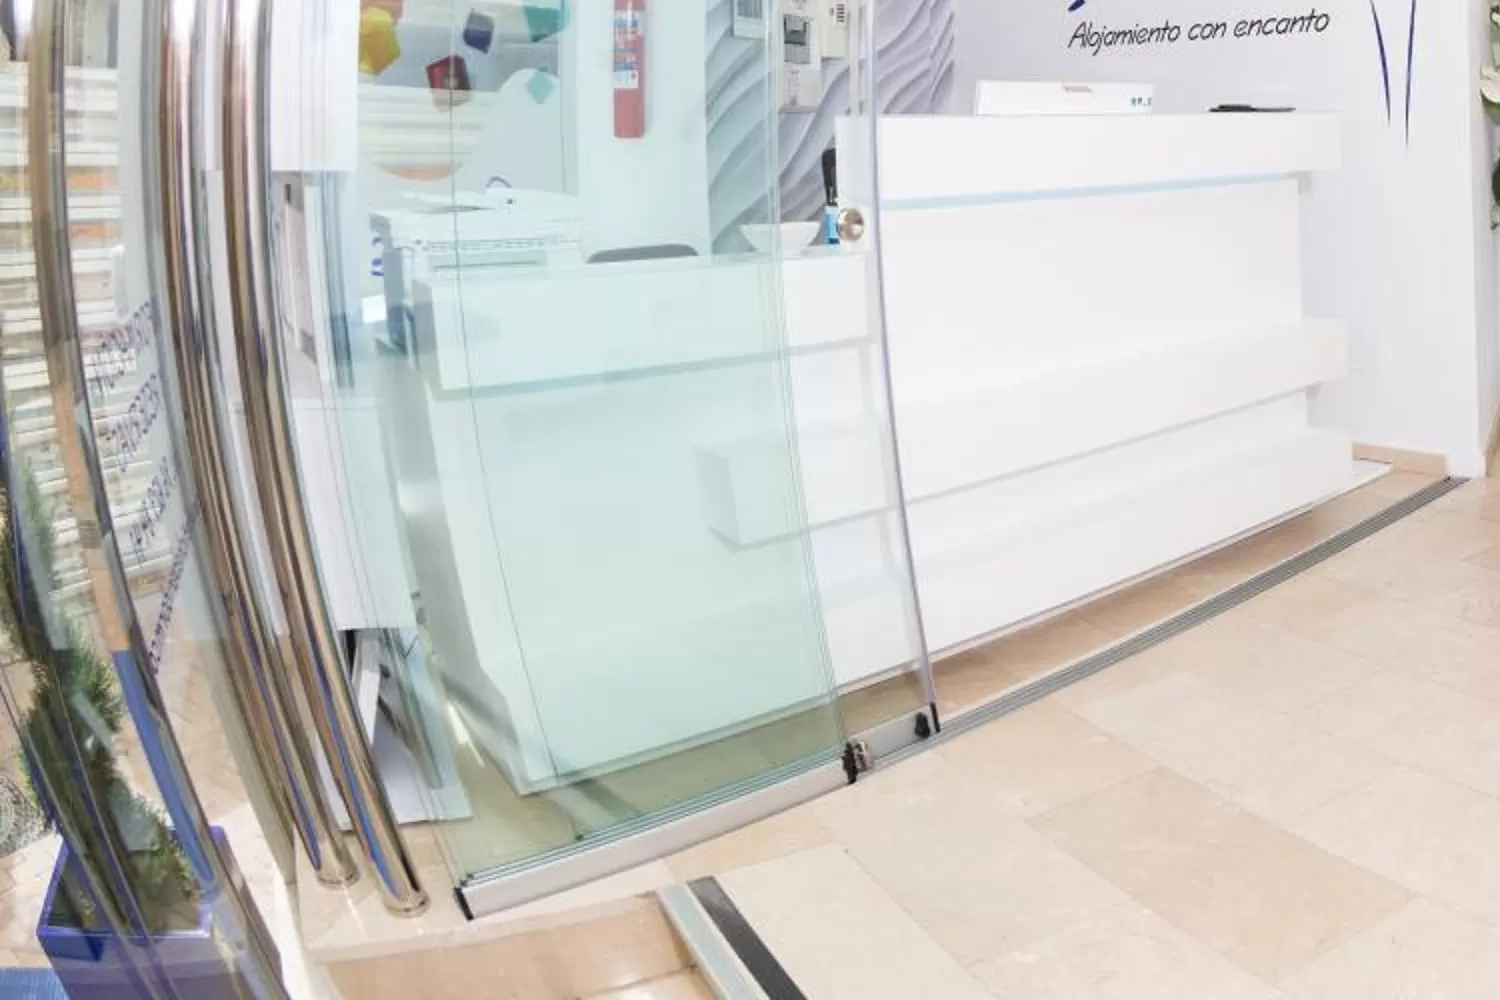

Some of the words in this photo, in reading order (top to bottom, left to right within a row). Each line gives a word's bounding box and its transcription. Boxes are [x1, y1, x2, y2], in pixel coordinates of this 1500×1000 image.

[1067, 19, 1181, 56] Alojamiento
[1188, 20, 1228, 40] con
[1232, 7, 1330, 38] encanto
